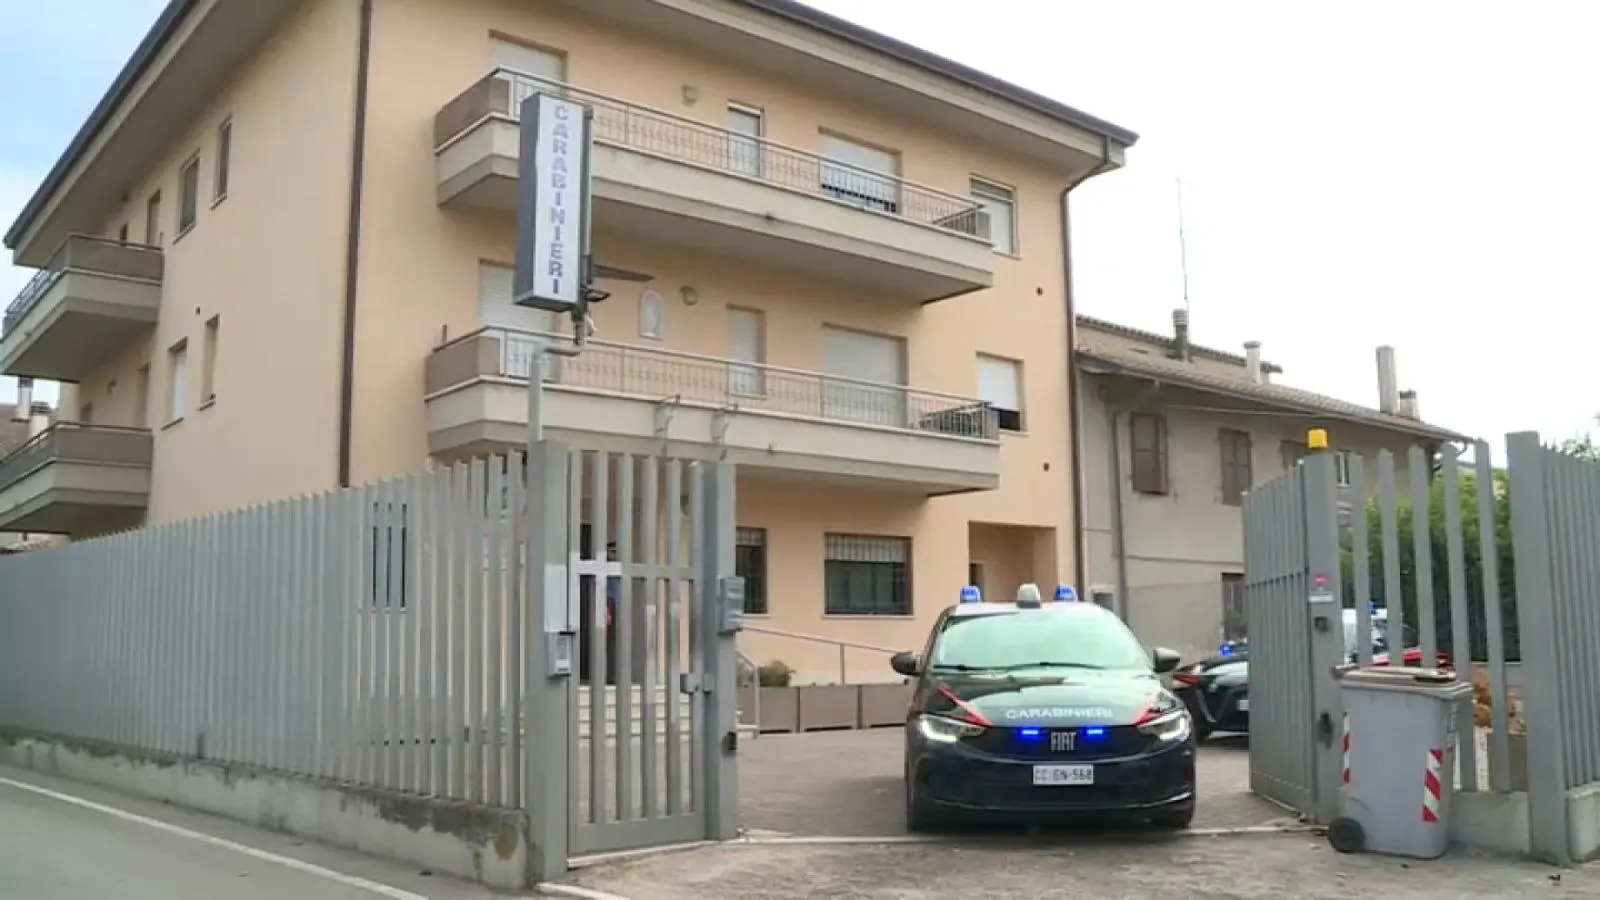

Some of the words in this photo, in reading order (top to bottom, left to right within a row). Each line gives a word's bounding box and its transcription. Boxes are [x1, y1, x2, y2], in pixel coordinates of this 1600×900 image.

[548, 105, 569, 295] CARABINIERI
[1006, 706, 1114, 720] CARABINIERI
[1050, 731, 1077, 752] FIAT
